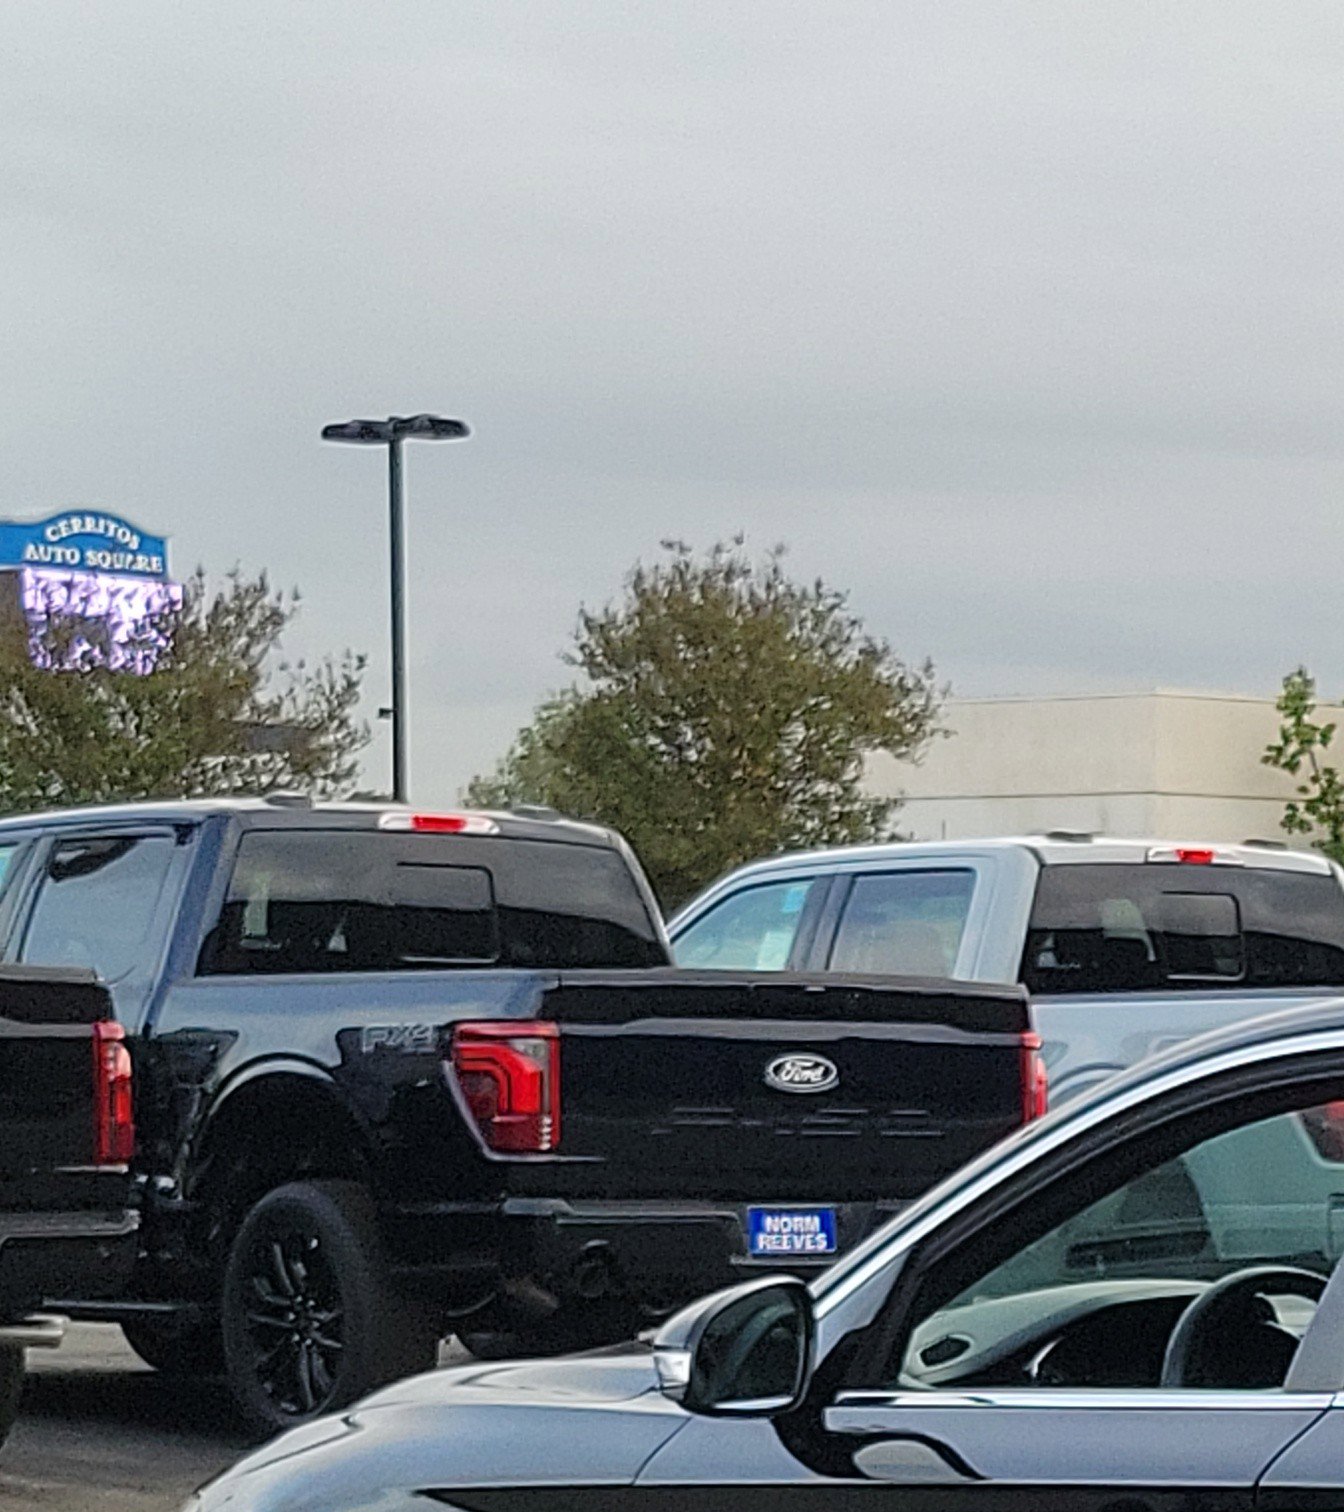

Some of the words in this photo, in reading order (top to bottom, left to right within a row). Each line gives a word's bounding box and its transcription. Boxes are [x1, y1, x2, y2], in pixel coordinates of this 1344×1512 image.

[45, 515, 141, 551] CERRITOS
[24, 544, 81, 565] AUTO
[86, 550, 163, 573] SQUARE
[764, 1215, 821, 1233] NORM
[756, 1233, 829, 1251] REEVES
